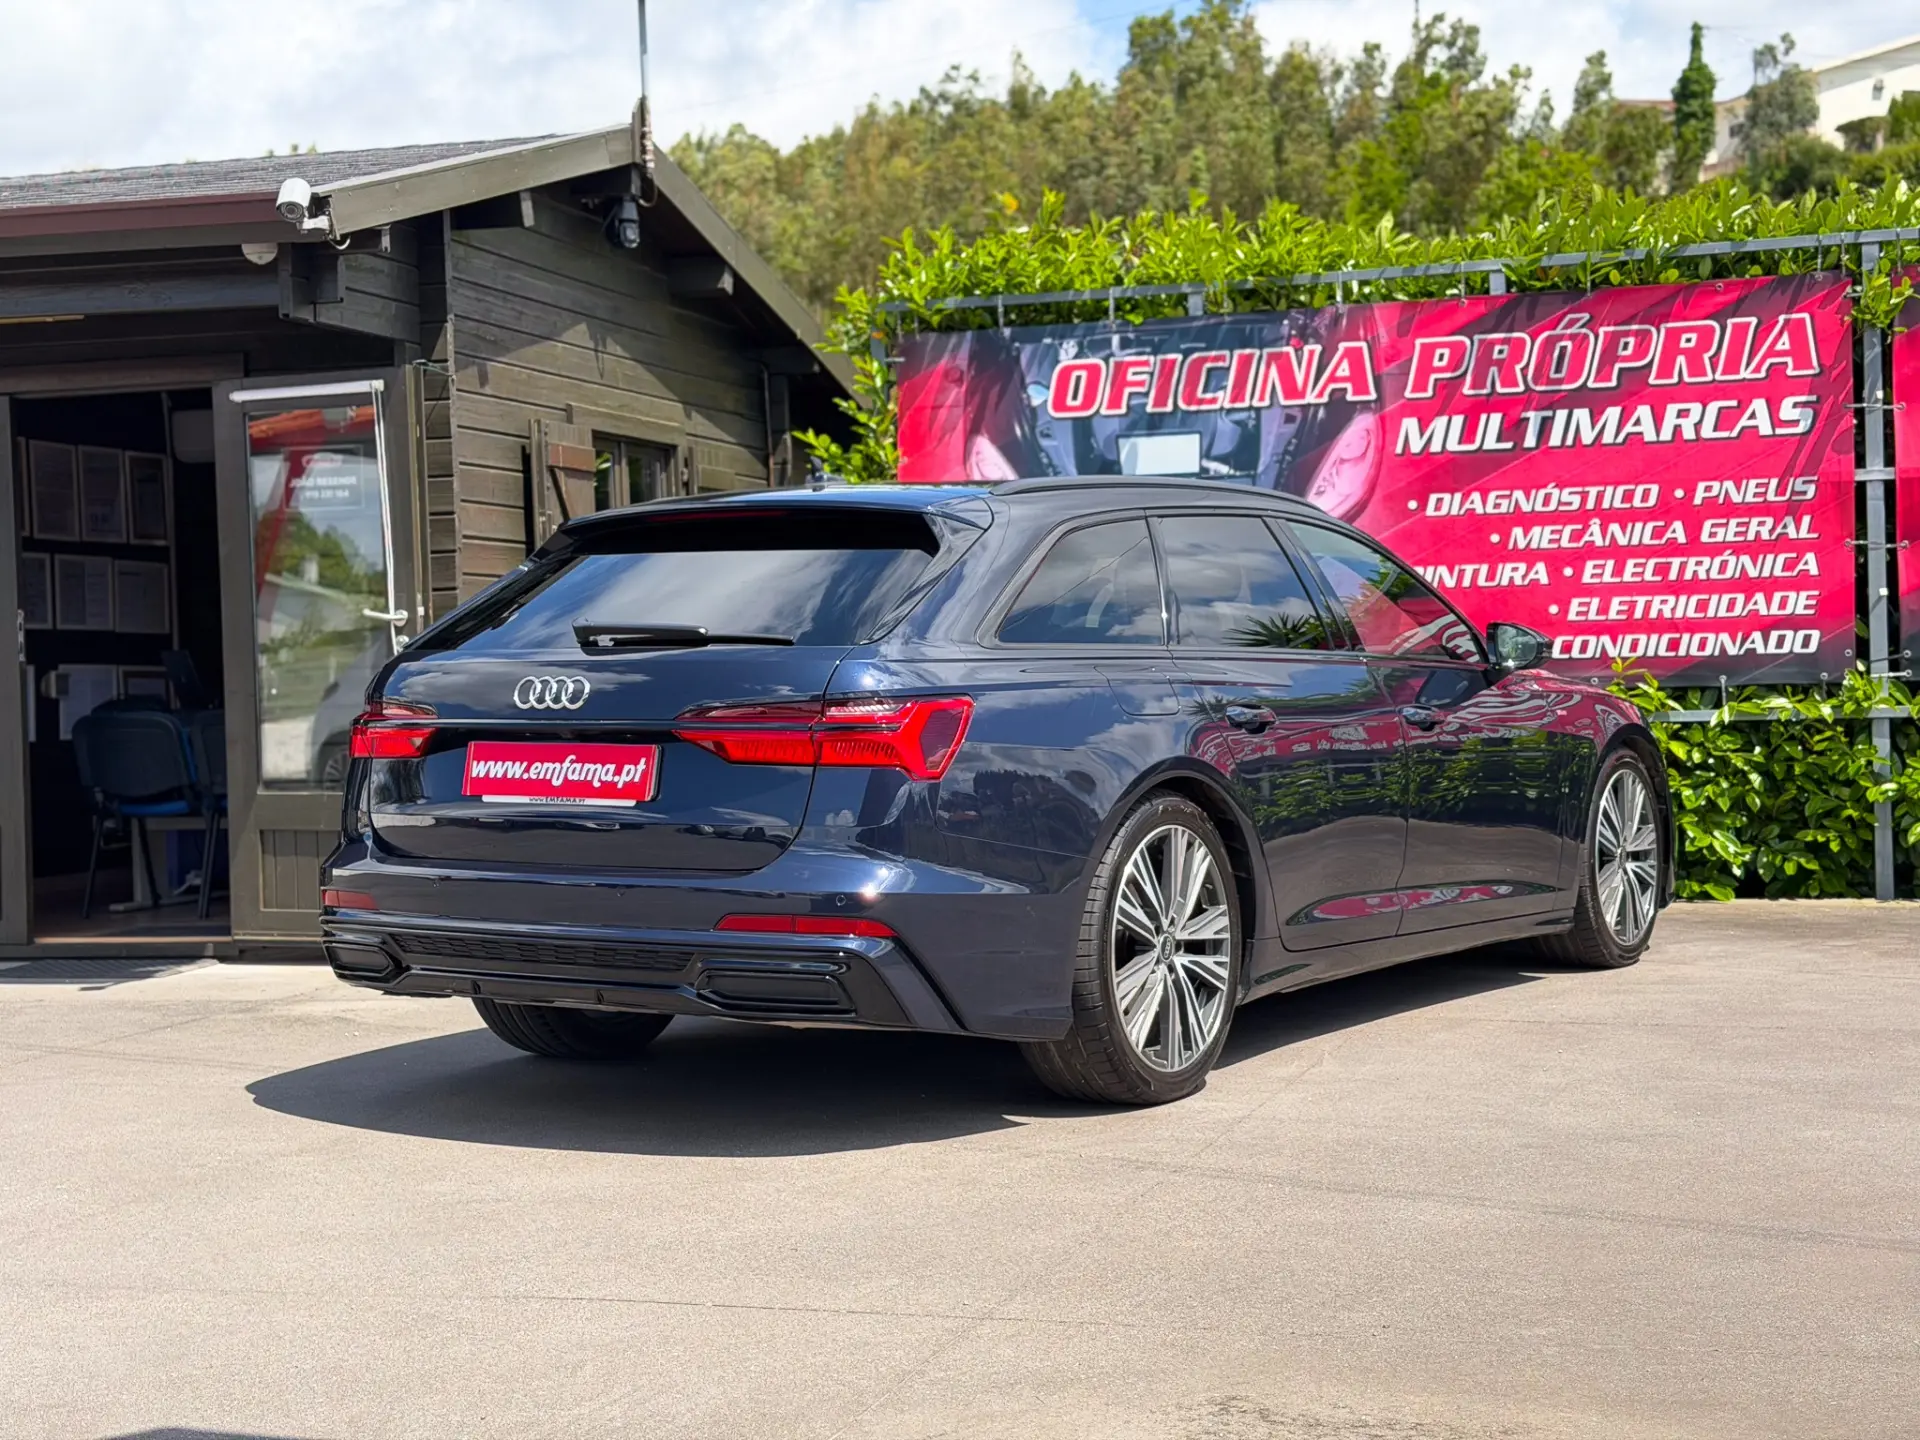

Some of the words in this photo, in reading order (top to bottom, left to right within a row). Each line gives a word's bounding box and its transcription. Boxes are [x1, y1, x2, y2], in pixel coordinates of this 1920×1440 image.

[1047, 341, 1378, 420] OFICINA
[1403, 312, 1821, 400] PRÓPRIA
[1395, 394, 1818, 455] MULTIMARCAS
[1425, 482, 1660, 518] DIAGNÓSTICO
[1693, 476, 1819, 506] PNEUS
[1508, 517, 1687, 551] MECÂNICA
[1700, 515, 1820, 544] GERAL
[1581, 550, 1820, 585] ELECTRÓNICA
[1567, 590, 1821, 622] ELETRICIDADE
[1551, 629, 1822, 660] CONDICIONADO
[471, 754, 647, 789] www.emfama.pt
